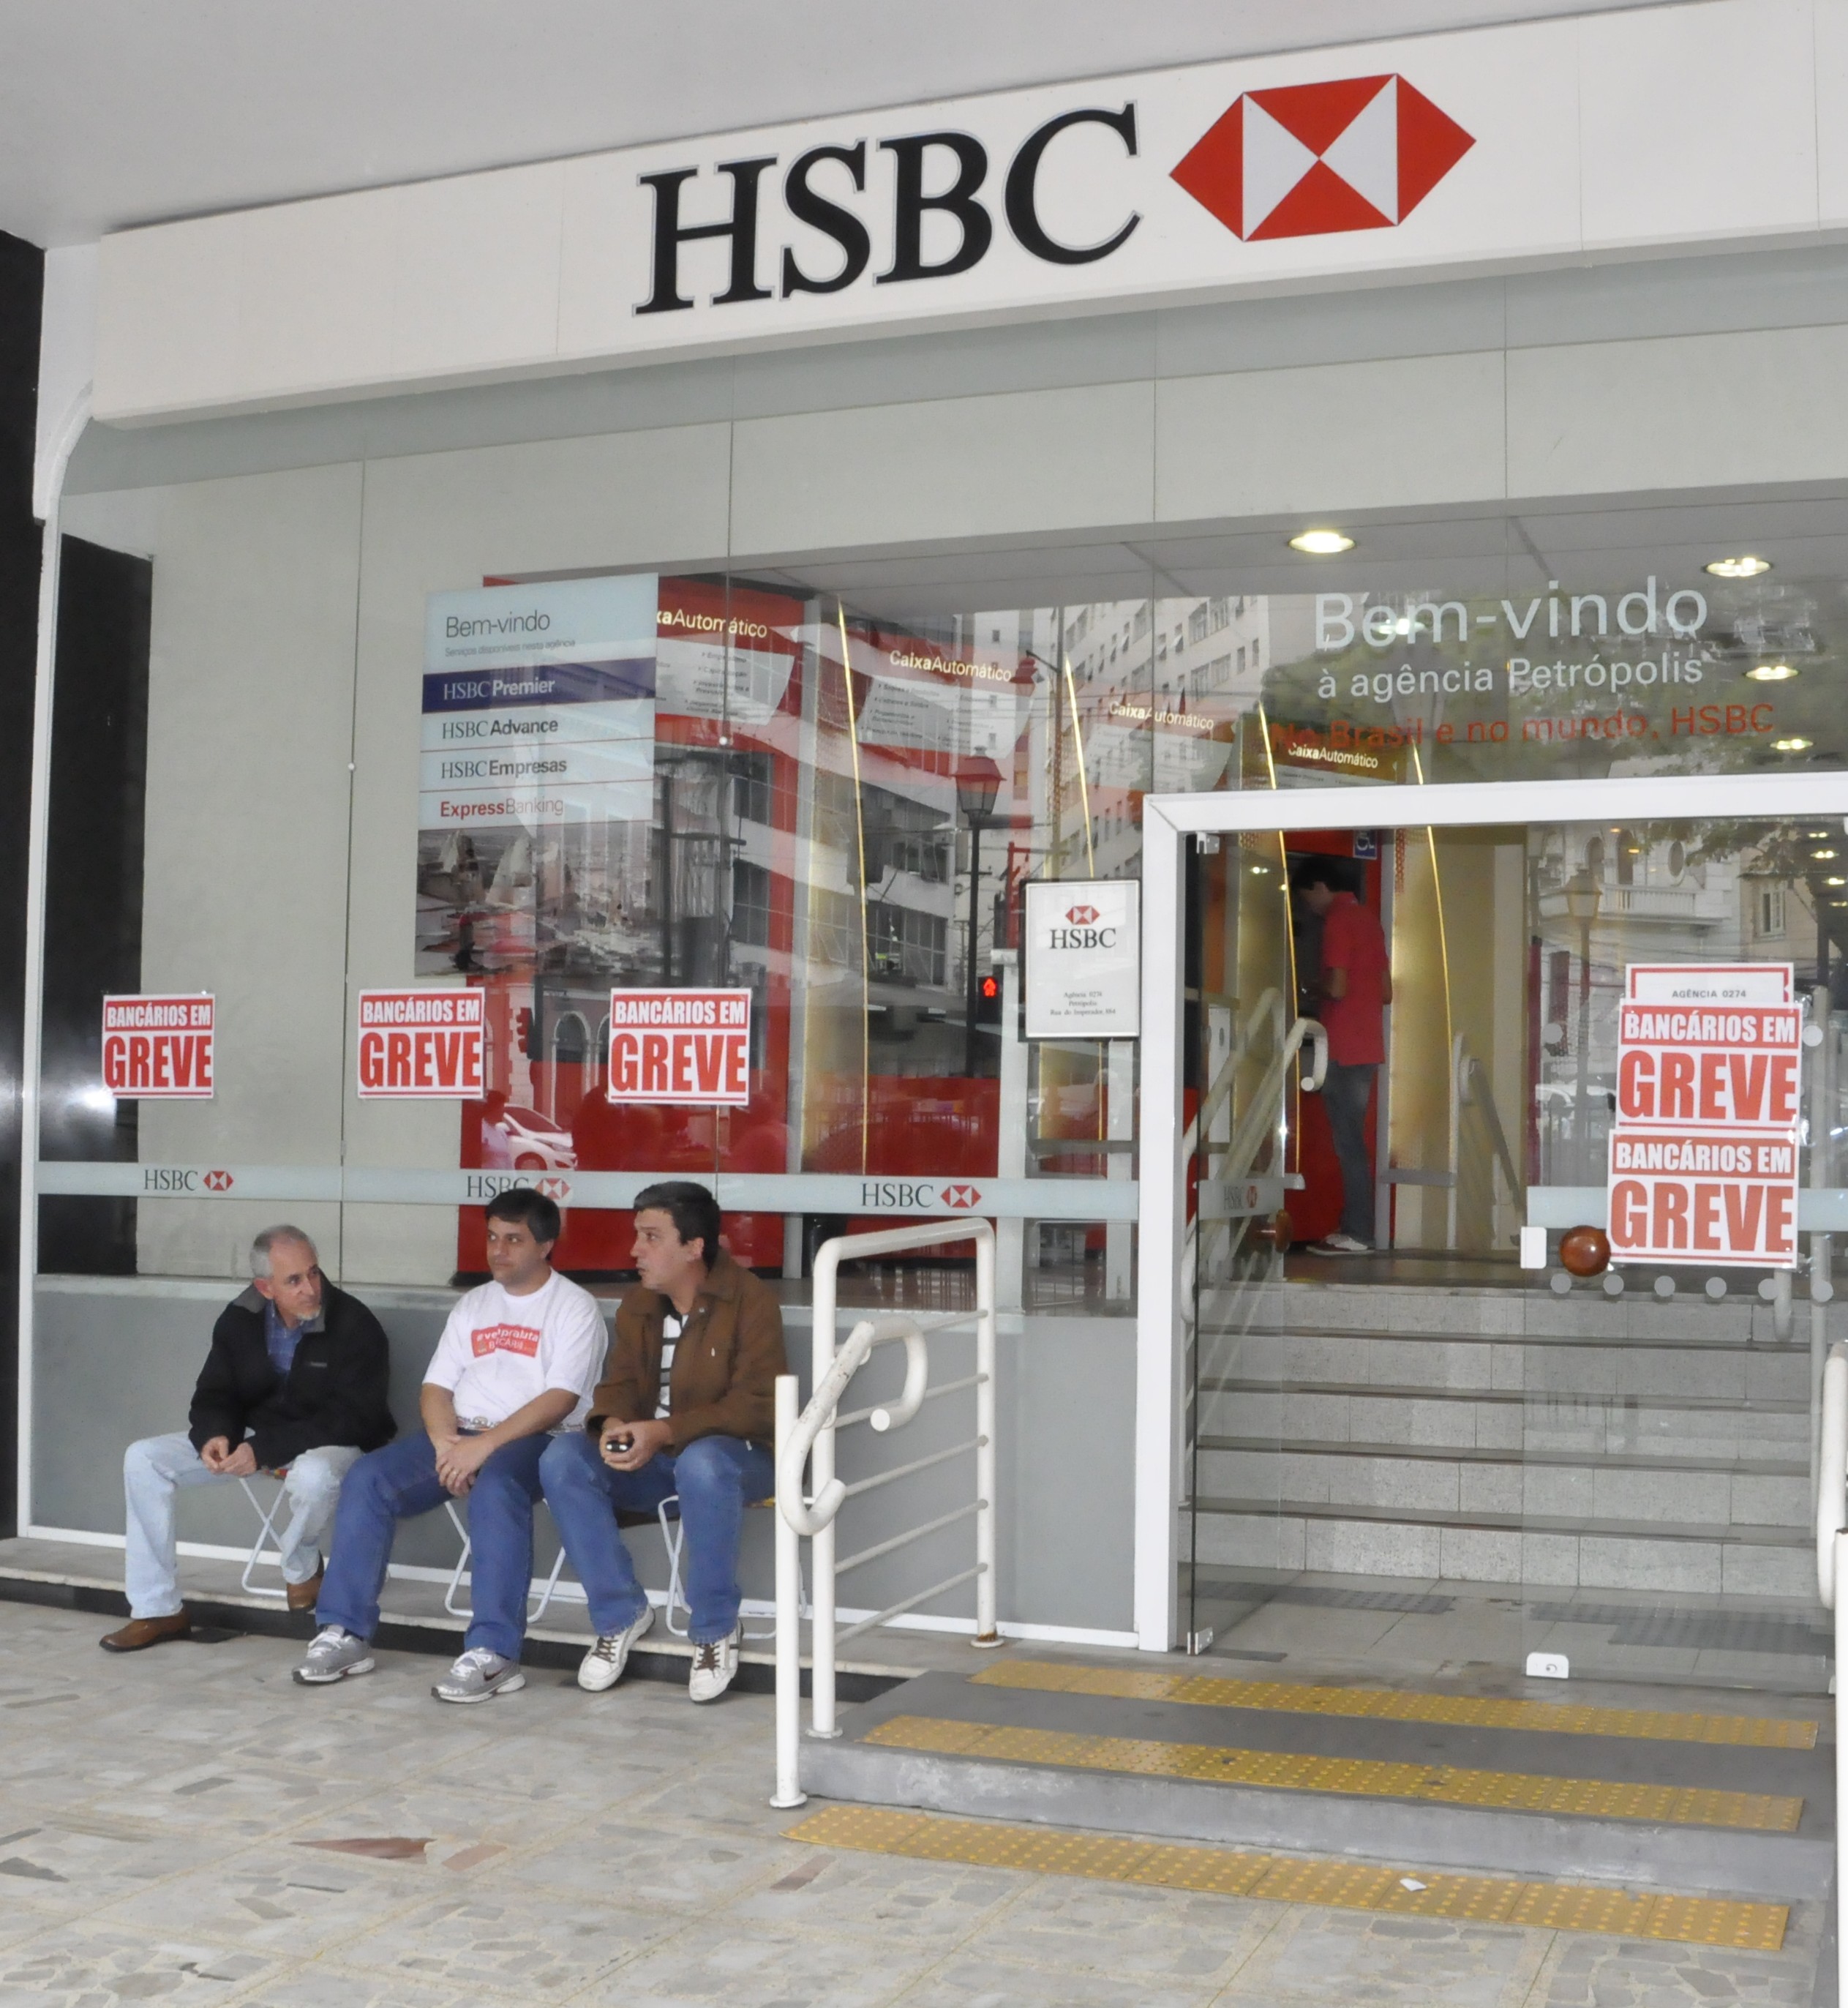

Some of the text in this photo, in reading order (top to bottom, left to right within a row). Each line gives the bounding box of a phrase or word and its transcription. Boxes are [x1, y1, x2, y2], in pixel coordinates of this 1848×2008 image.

[631, 100, 1144, 318] HSBC
[445, 610, 551, 638] Bem-vindo
[1315, 575, 1708, 651] Bem-vindo
[889, 650, 1013, 683] CaixaAutomático
[1317, 651, 1704, 704] à agência Petrópolis
[443, 677, 556, 700] HSBC Premier
[441, 719, 559, 739] HSBC Advance
[1329, 717, 1423, 749] Brasil
[1435, 721, 1455, 745] e
[1467, 720, 1510, 743] no
[1670, 703, 1775, 735] HSBC
[440, 759, 568, 779] HSBC Empresas
[1048, 927, 1116, 950] HSBC
[363, 996, 480, 1024] BANCÁRIOS EM
[615, 996, 745, 1024] BANCÁRIOS EM
[1672, 988, 1747, 999] AGÊNCIA 0274
[107, 1002, 211, 1027] BANCÁRIOS EM
[1624, 1010, 1796, 1044] BANCÁRIOS EM
[104, 1035, 212, 1088] GREVE
[359, 1031, 482, 1088] GREVE
[611, 1033, 747, 1093] GREVE
[1618, 1049, 1798, 1122] GREVE
[1615, 1139, 1792, 1174] BANCÁRIOS EM
[143, 1169, 198, 1191] HSBC
[860, 1183, 935, 1209] HSBC
[1610, 1179, 1794, 1254] GREVE
